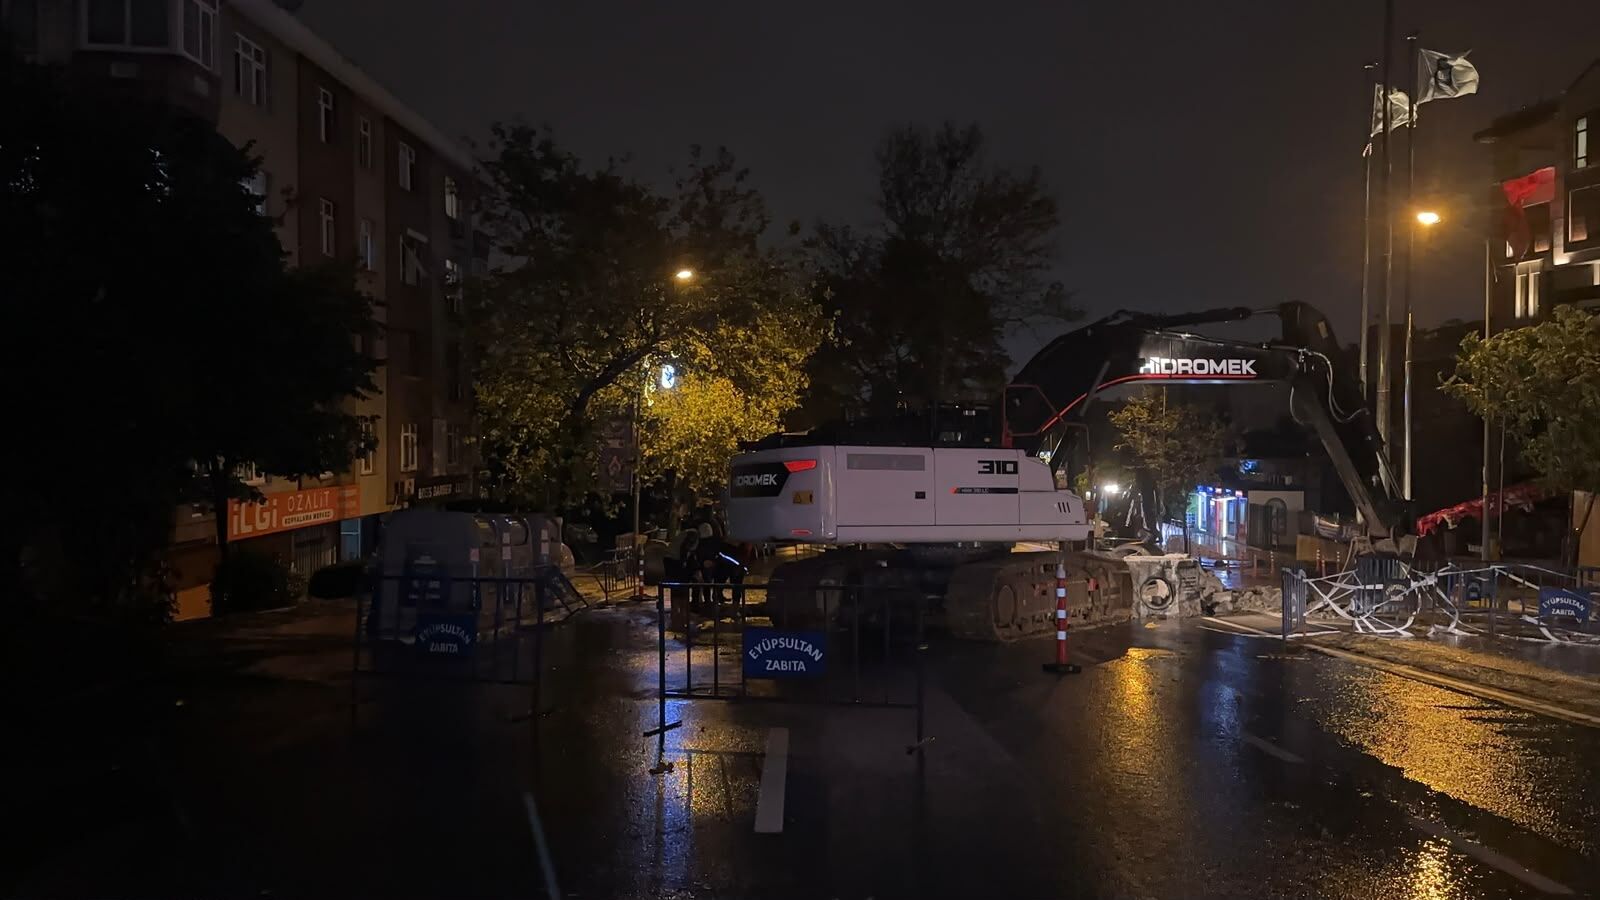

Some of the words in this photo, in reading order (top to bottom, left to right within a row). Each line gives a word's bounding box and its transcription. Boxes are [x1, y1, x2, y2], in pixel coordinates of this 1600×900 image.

[978, 460, 1018, 474] 310
[1551, 608, 1576, 617] ZABITA
[430, 641, 458, 654] ZABITA
[748, 637, 823, 662] EYÜPSULTAN
[766, 659, 806, 672] ZABITA
